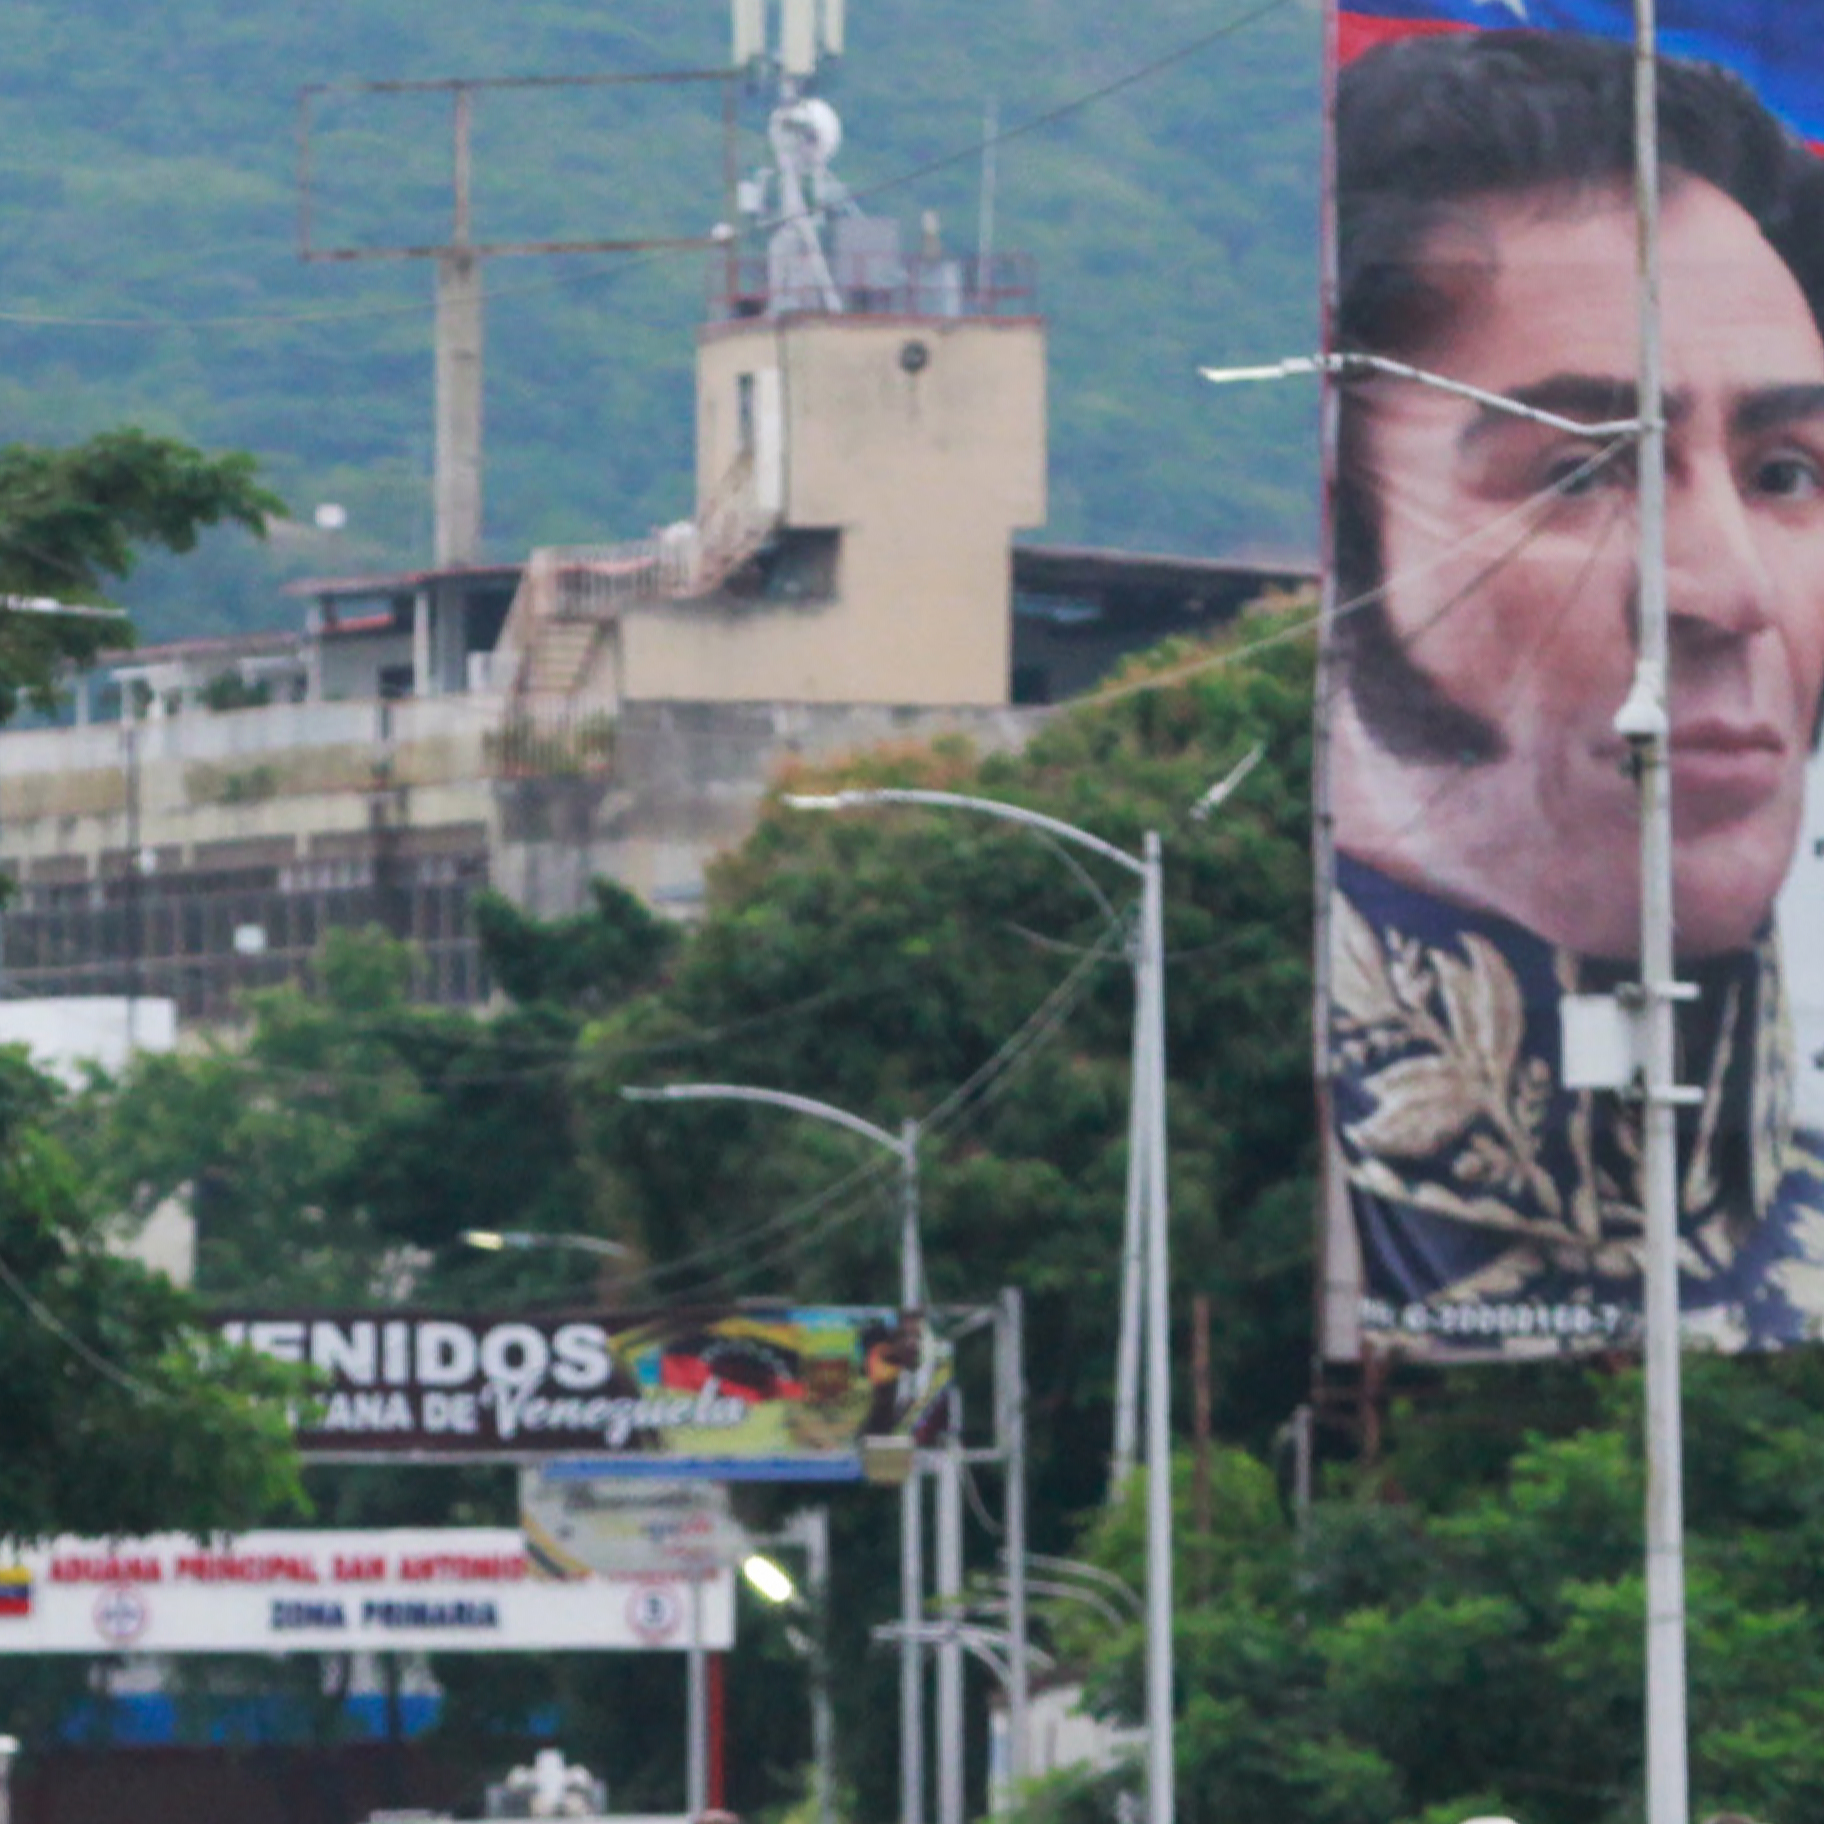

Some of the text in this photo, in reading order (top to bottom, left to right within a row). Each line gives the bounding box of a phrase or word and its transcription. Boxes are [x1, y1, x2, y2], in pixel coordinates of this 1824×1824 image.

[422, 1391, 480, 1434] DE
[478, 1376, 748, 1447] Venezuela
[49, 1554, 529, 1583] ADUANA PRINCIPAL SAN ANTONIO
[270, 1599, 498, 1629] ZONA PRIMARIA
